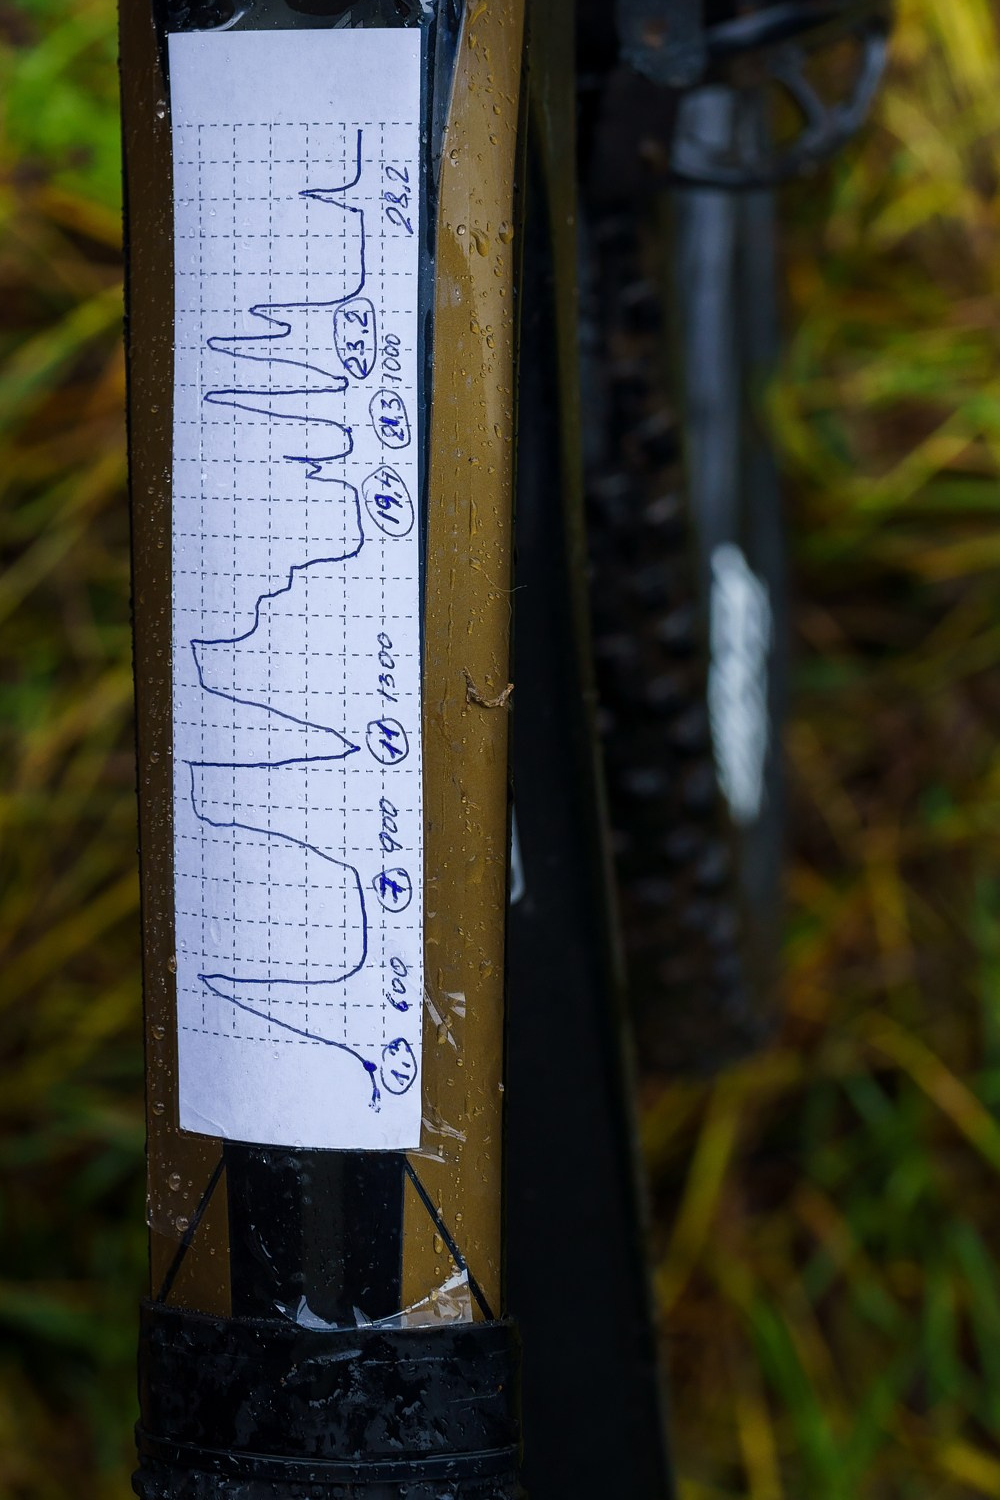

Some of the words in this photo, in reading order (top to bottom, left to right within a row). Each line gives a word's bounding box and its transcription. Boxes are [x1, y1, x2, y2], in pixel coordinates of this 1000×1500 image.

[382, 333, 402, 382] 1000
[376, 631, 399, 703] 1300
[378, 798, 404, 853] 900
[385, 956, 409, 1013] 600
